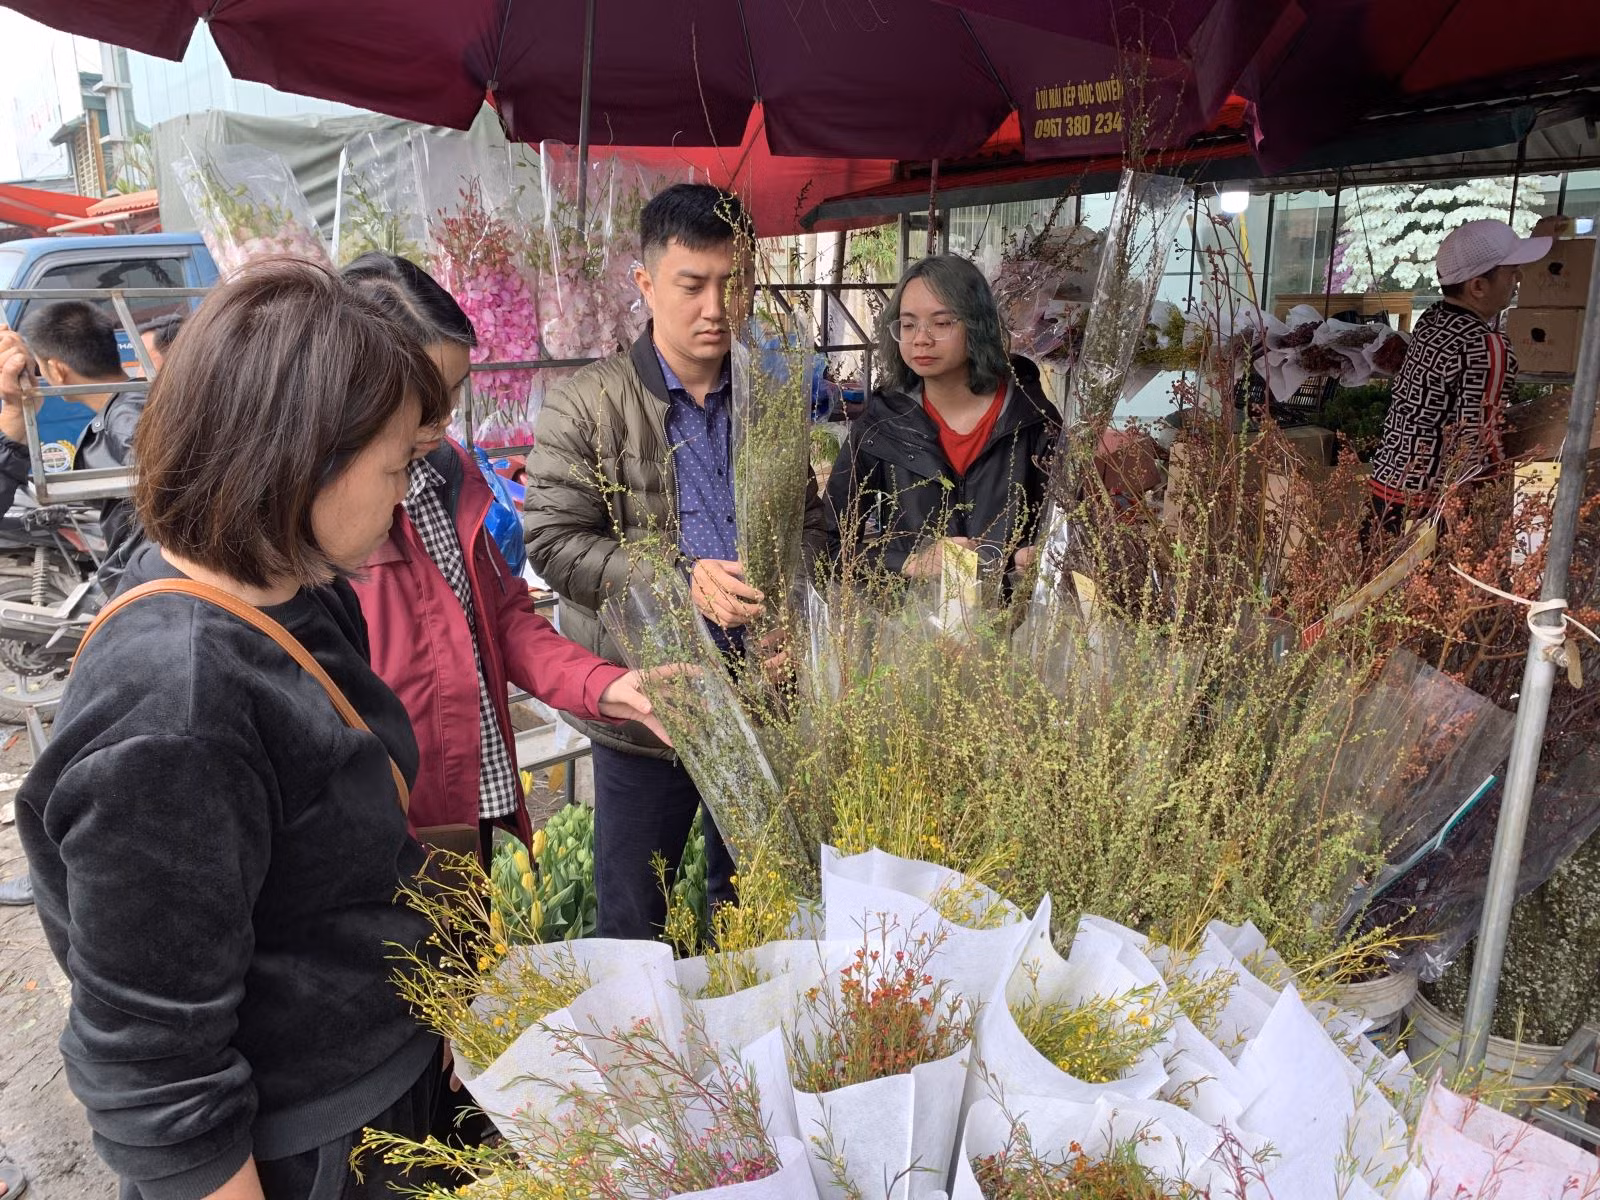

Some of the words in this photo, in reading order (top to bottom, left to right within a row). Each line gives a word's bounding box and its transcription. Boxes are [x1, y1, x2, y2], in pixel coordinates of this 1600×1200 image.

[1062, 80, 1076, 107] XẾP
[1077, 80, 1095, 109] ĐỘC
[1034, 118, 1062, 139] 0967
[1065, 115, 1090, 137] 380
[1094, 112, 1123, 134] 234
